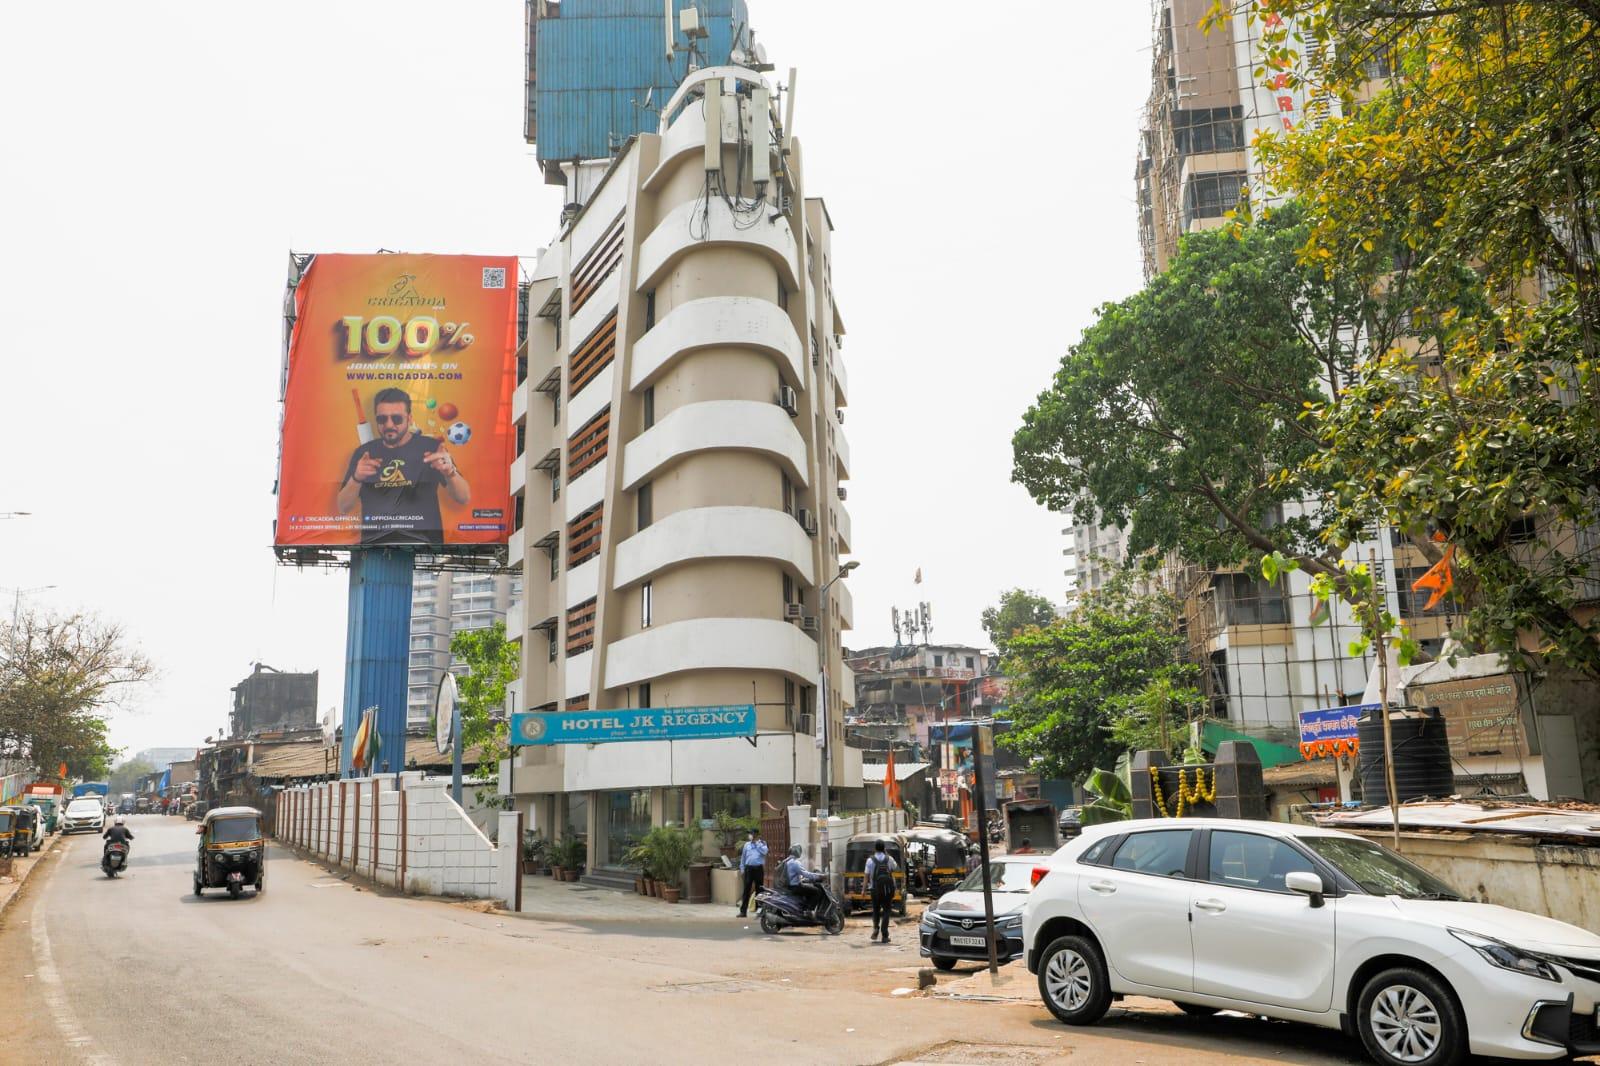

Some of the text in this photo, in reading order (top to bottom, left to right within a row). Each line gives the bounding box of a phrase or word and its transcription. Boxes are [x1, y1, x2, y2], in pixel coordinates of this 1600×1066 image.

[346, 362, 396, 371] JOINING
[346, 372, 463, 381] WWW.CRICADDA.COM
[562, 711, 749, 730] HOTEL JK REGENCY
